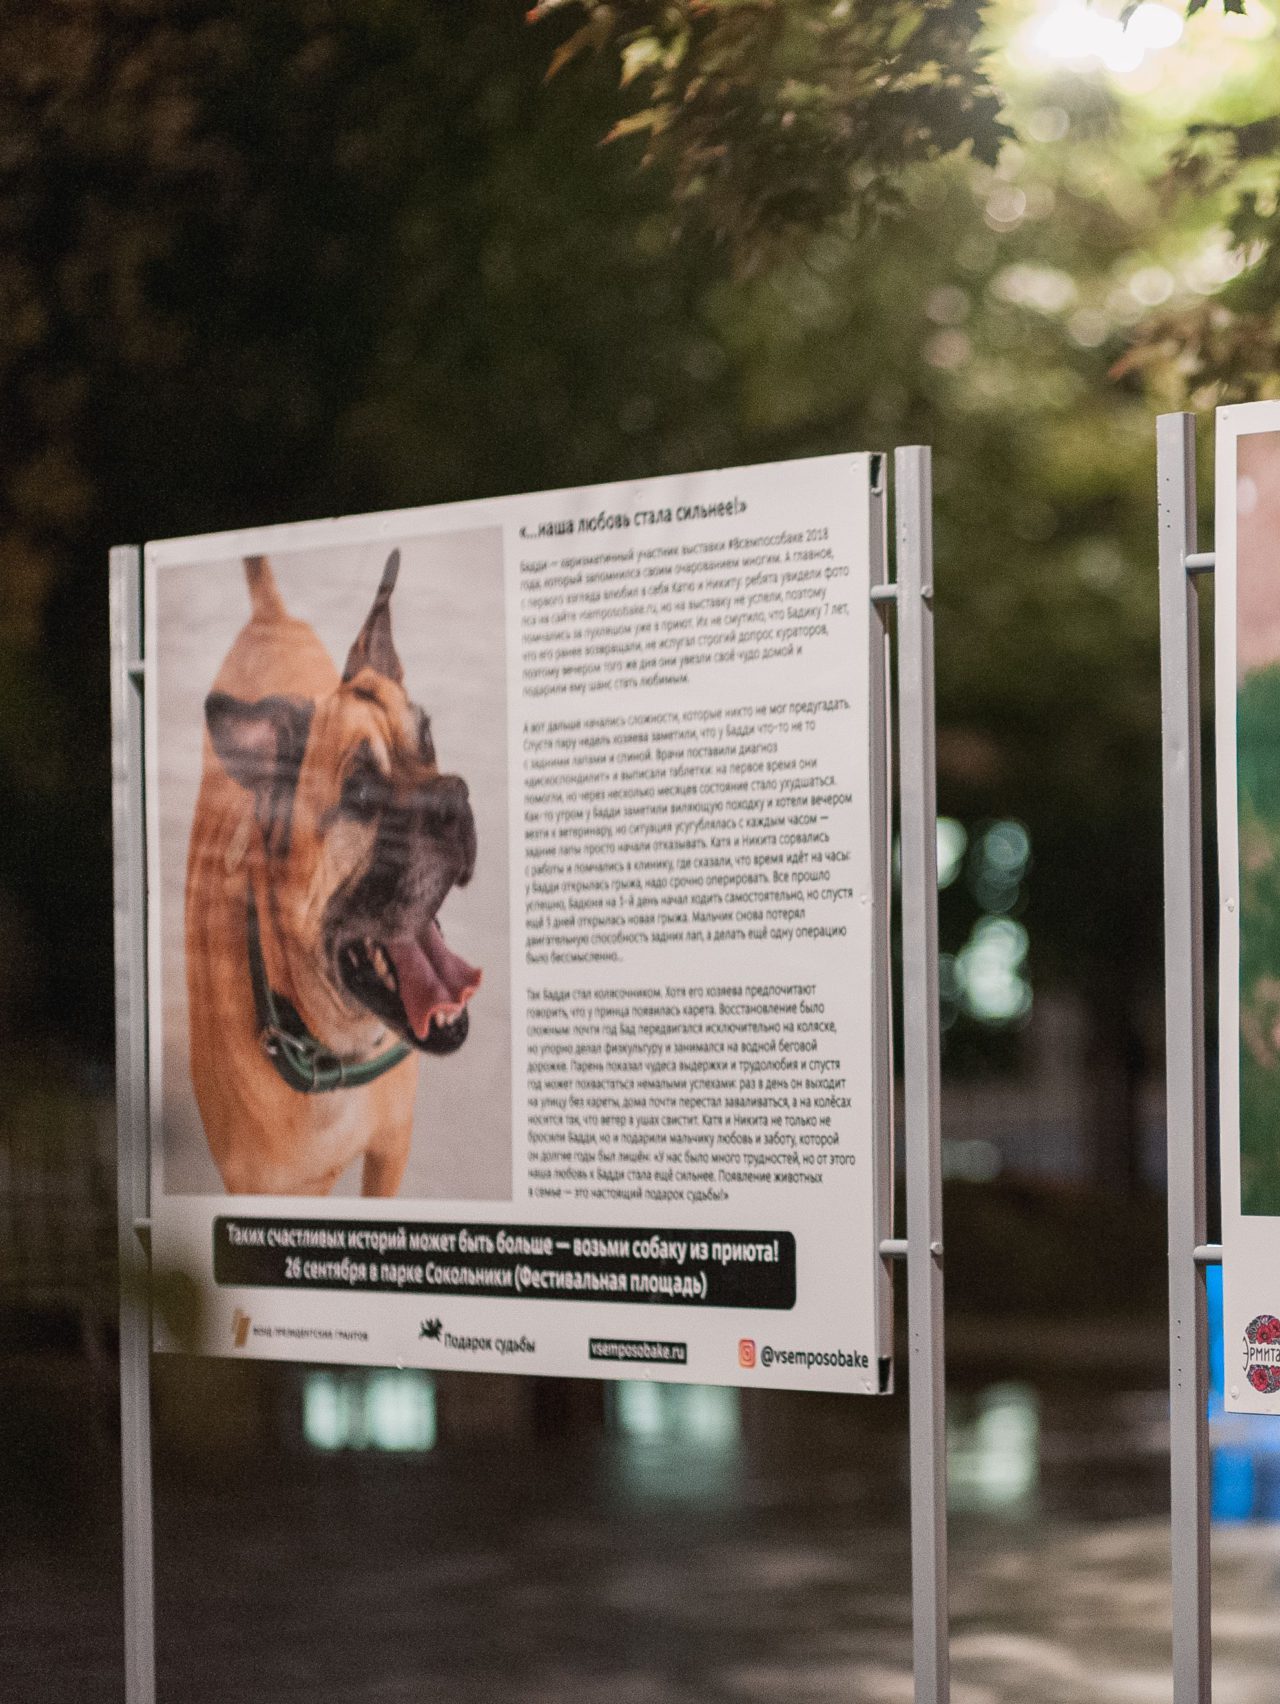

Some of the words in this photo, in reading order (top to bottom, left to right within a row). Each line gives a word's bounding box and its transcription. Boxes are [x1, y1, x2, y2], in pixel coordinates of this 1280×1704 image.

[577, 510, 631, 532] любовь
[633, 507, 672, 526] стала
[675, 496, 747, 522] сильнее!»
[718, 1002, 798, 1015] Восстановление
[799, 999, 825, 1014] было
[227, 1224, 264, 1244] Таких
[267, 1229, 345, 1247] счастливых
[348, 1227, 406, 1251] историй
[409, 1233, 456, 1251] может
[458, 1229, 494, 1253] быть
[496, 1231, 552, 1255] больше
[573, 1238, 629, 1257] возьми
[632, 1237, 686, 1264] собаку
[690, 1242, 708, 1260] из
[712, 1242, 778, 1265] приюта!
[285, 1257, 301, 1278] 26
[303, 1258, 367, 1283] сентября
[369, 1263, 378, 1281] в
[380, 1264, 423, 1285] парке
[425, 1262, 512, 1285] Сокольники
[514, 1265, 627, 1290] (Фестивальная
[630, 1273, 707, 1298] площадь)
[445, 1333, 492, 1350] Подарок
[495, 1336, 535, 1354] судьбы
[592, 1343, 685, 1361] vsemposobake.ru
[761, 1346, 868, 1369] @vsemposobake
